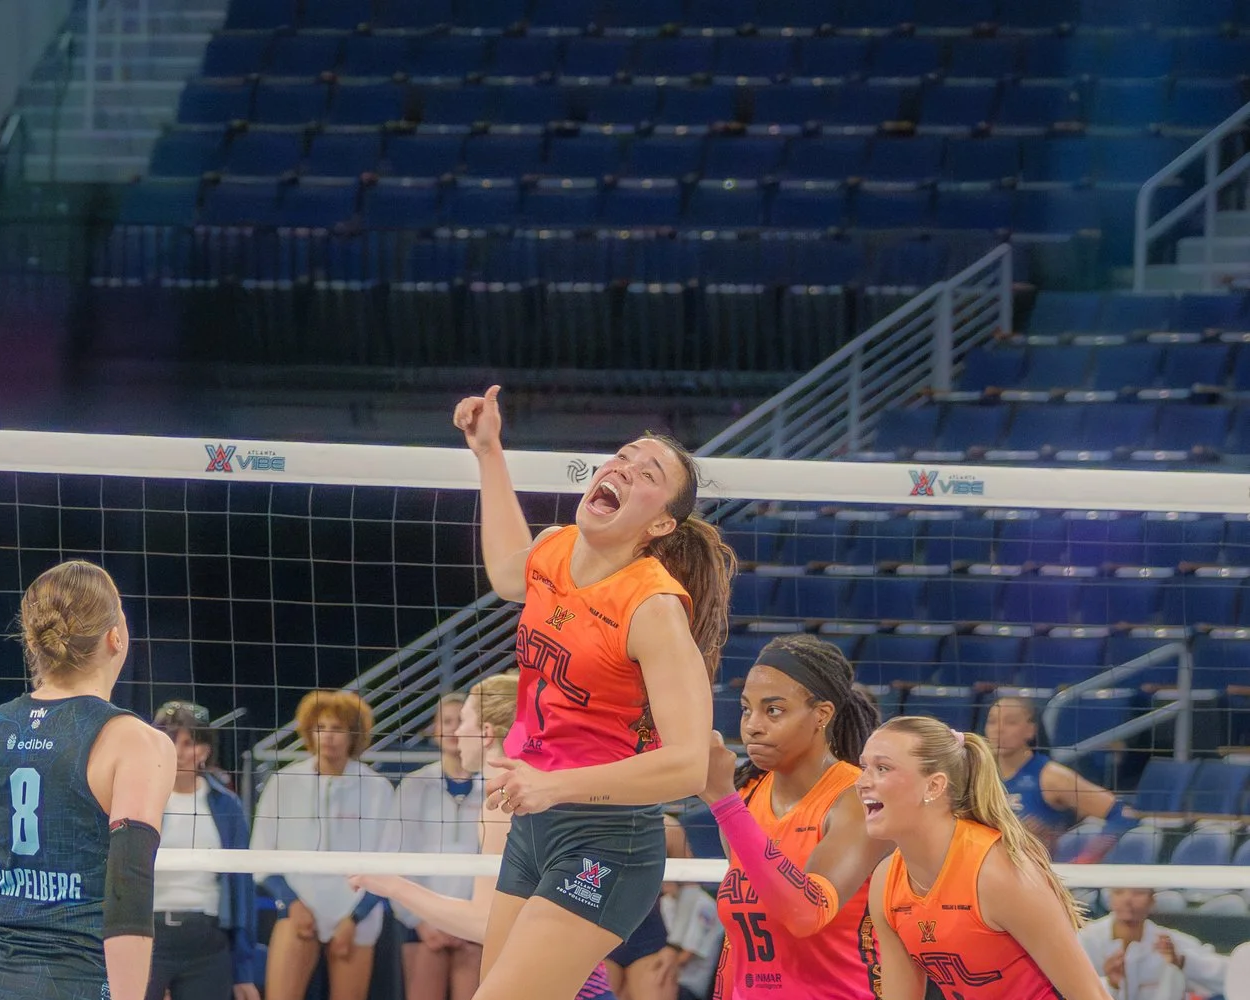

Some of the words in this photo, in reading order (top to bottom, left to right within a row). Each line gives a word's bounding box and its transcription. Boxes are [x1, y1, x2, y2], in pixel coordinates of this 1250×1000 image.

[236, 454, 286, 472] VIBE
[516, 623, 591, 707] ATL
[17, 739, 54, 750] edible
[9, 767, 41, 856] 8
[564, 878, 603, 904] VIBE
[574, 880, 597, 893] ATLANTA
[732, 912, 776, 963] 15
